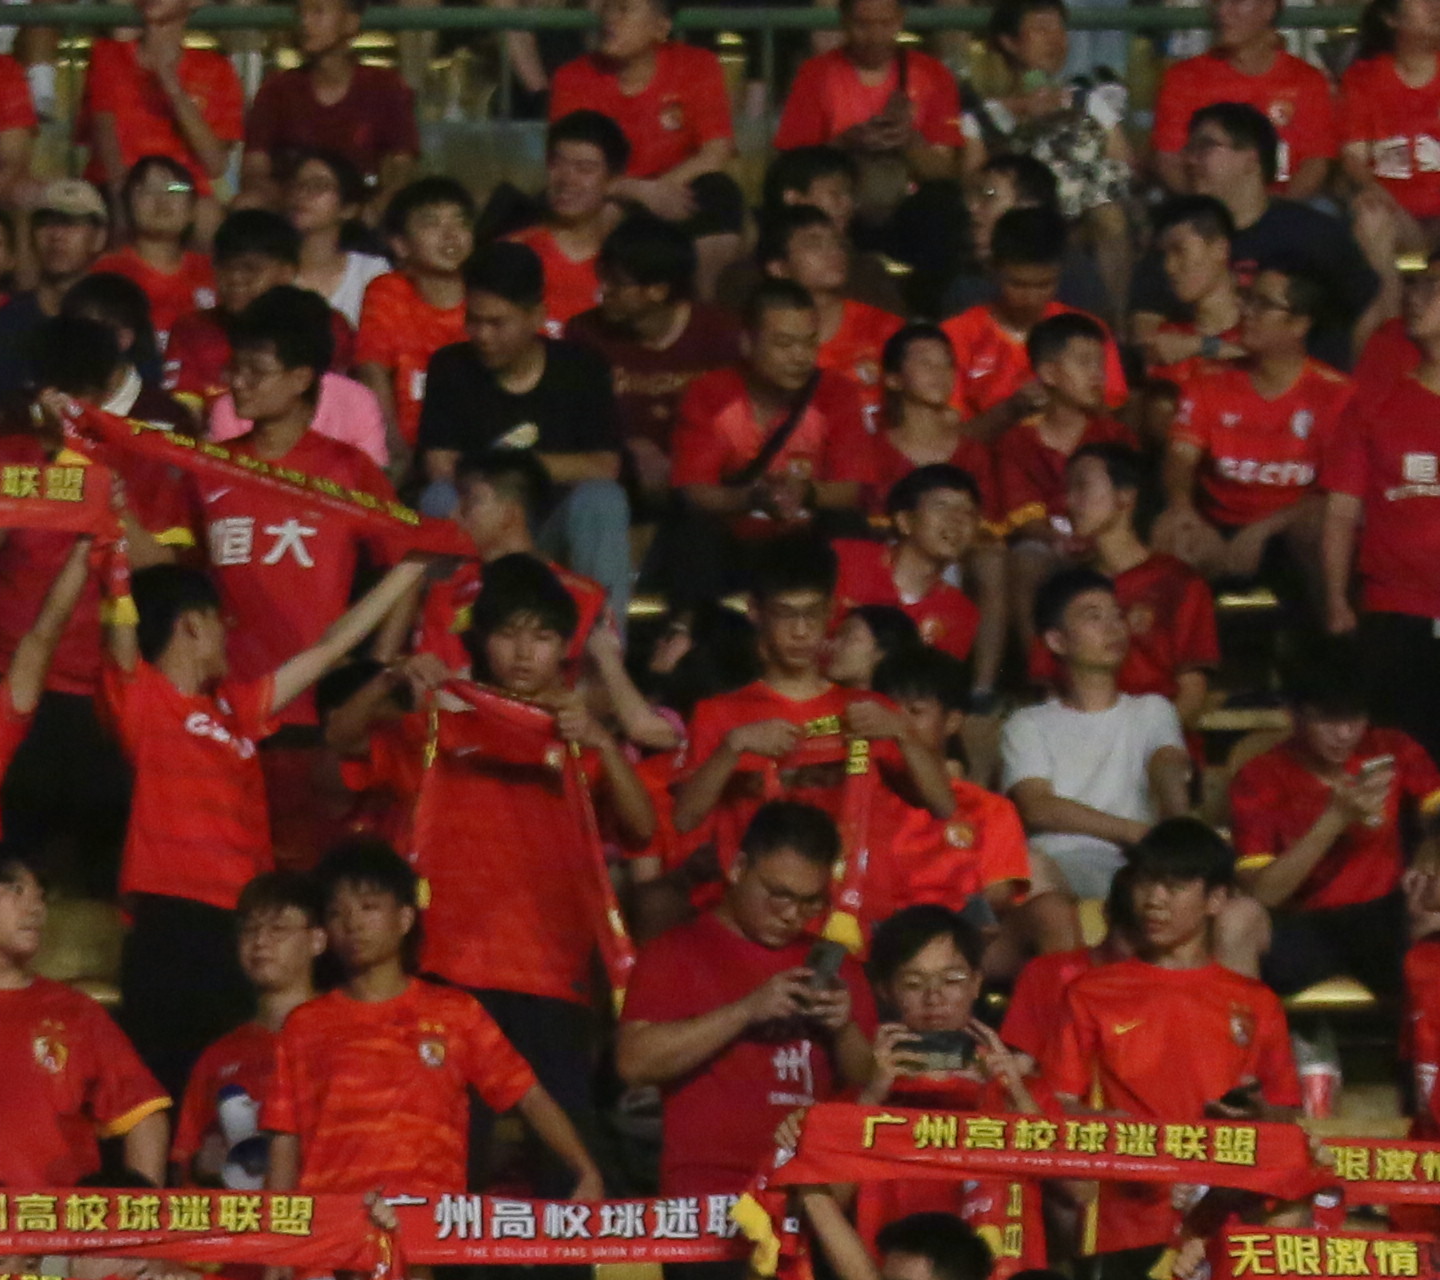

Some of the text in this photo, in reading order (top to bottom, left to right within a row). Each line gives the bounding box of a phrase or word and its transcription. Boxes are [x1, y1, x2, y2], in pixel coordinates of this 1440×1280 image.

[210, 516, 318, 568] 恒大
[863, 1113, 1257, 1167] 广州高校球迷联盟
[1228, 1233, 1419, 1278] 无限激情
